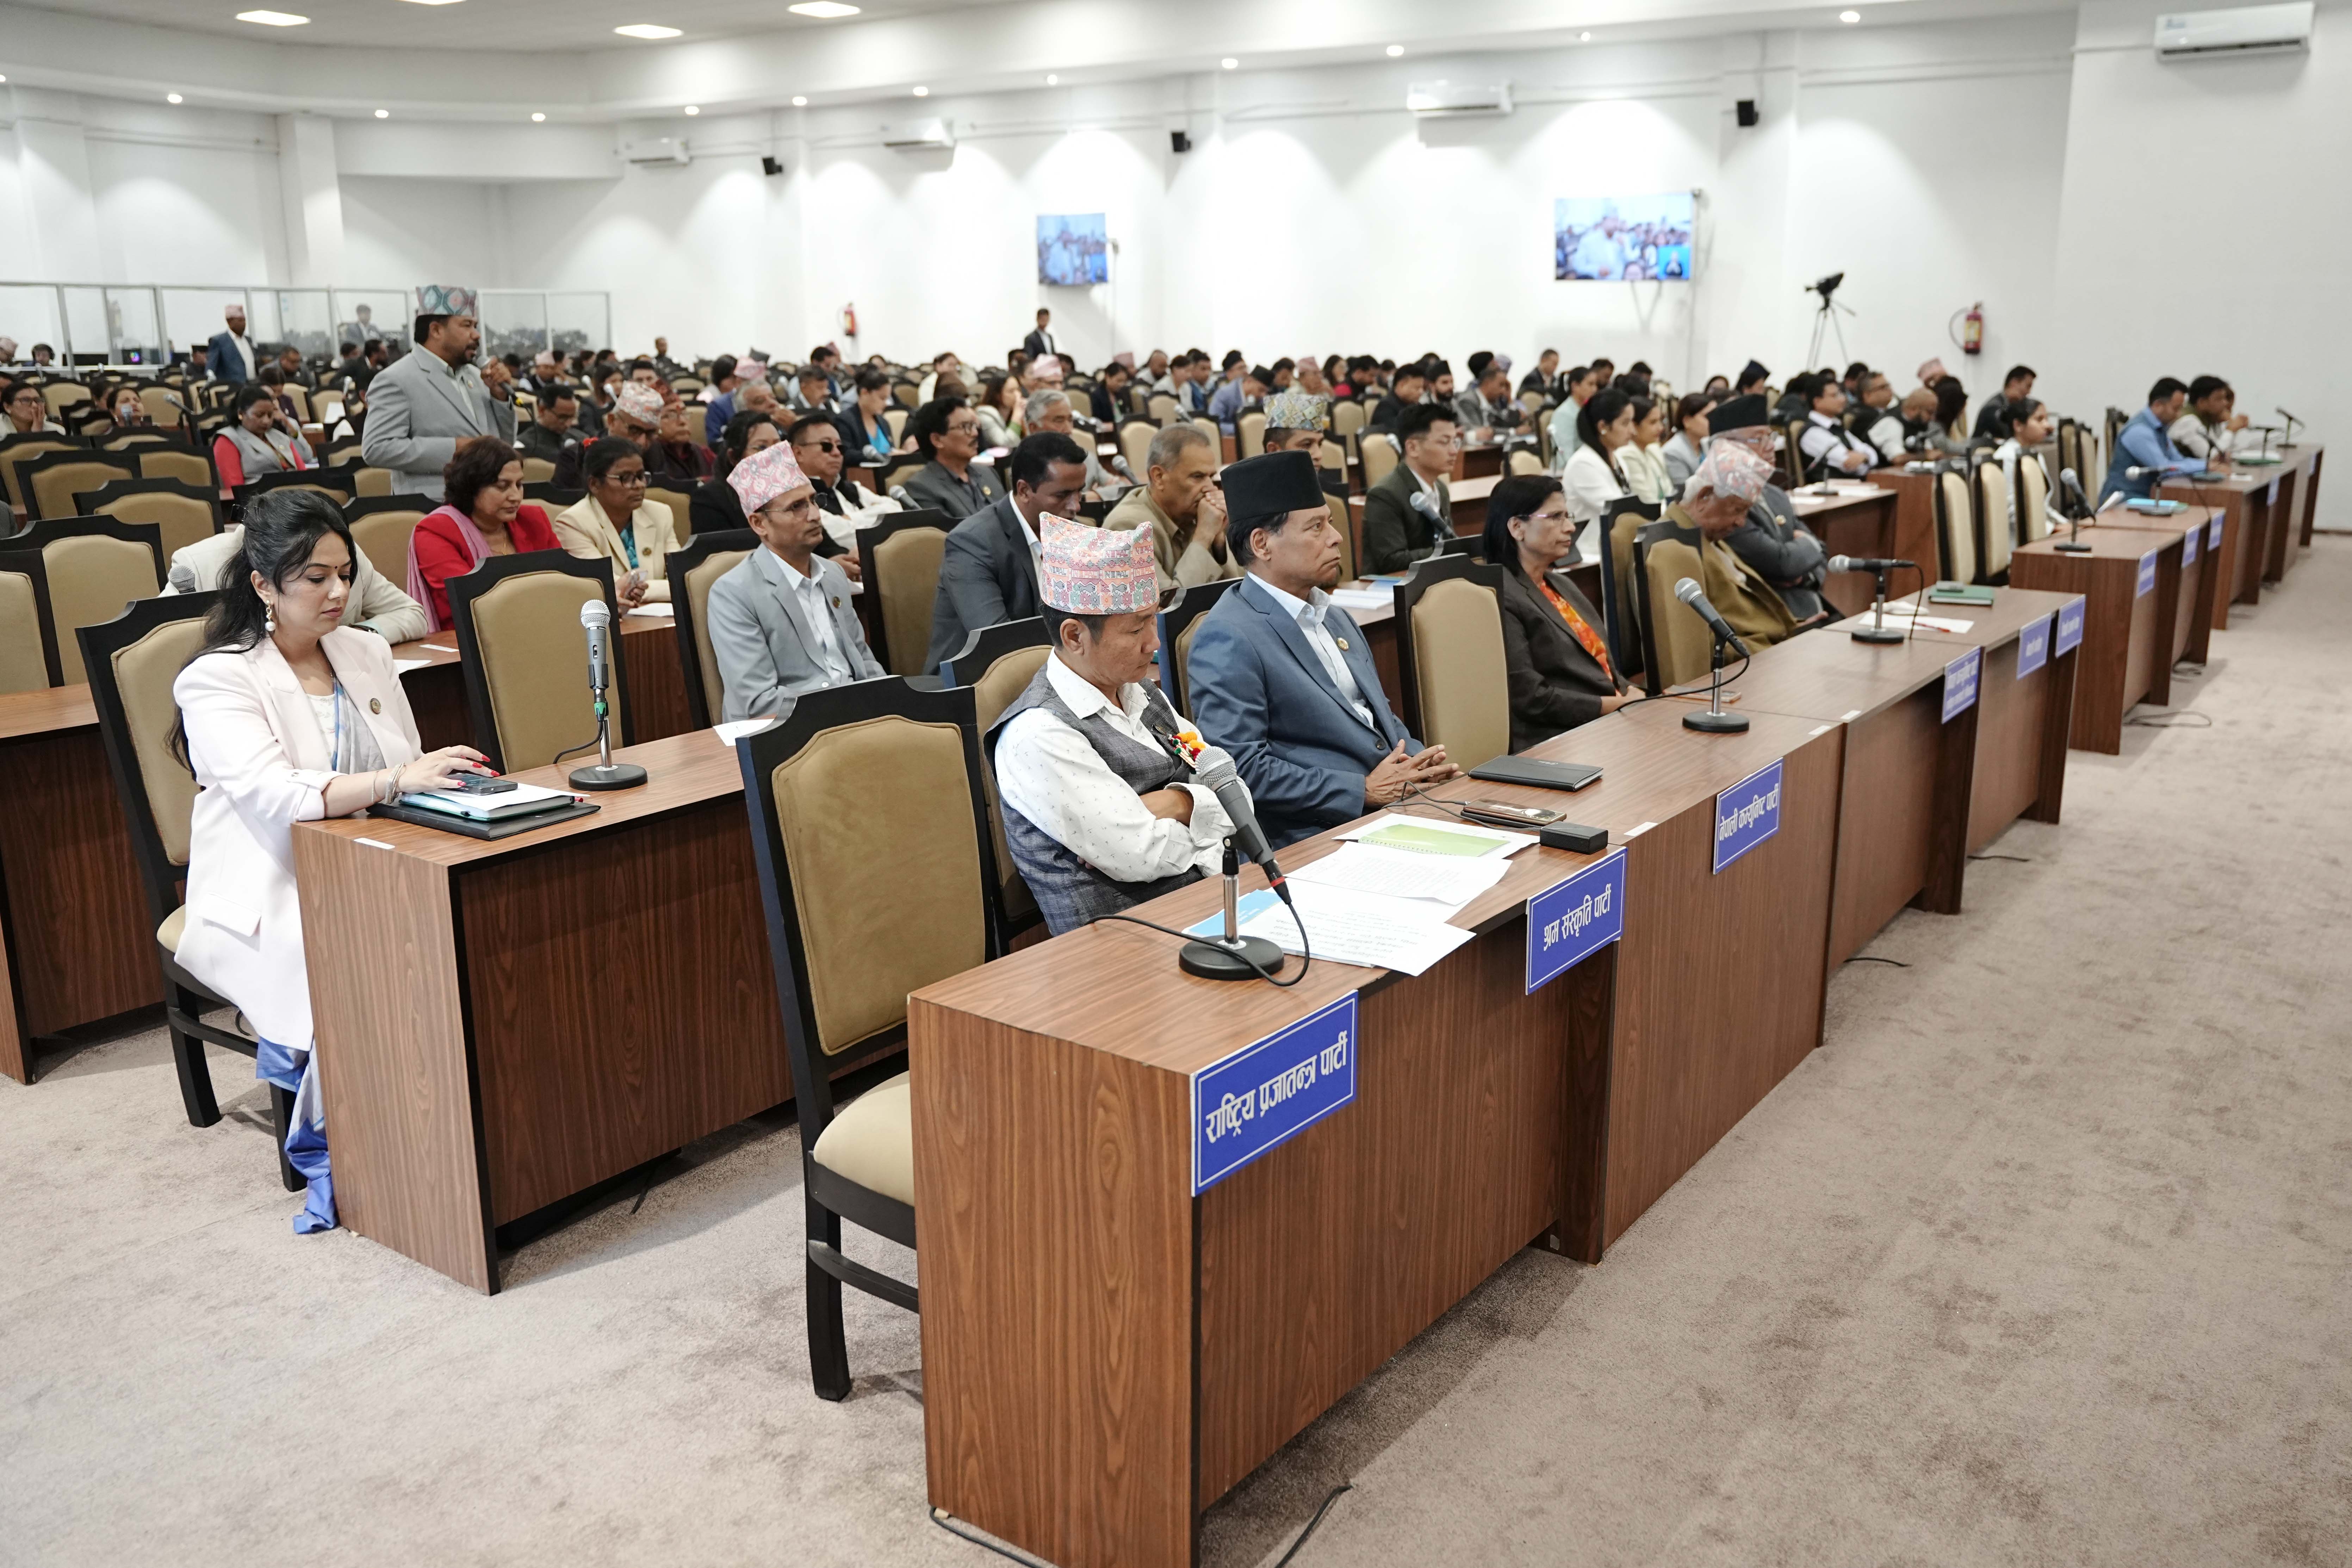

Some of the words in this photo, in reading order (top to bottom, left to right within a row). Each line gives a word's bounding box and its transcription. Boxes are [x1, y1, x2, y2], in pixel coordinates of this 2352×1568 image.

[1049, 565, 1067, 576] NEPAL
[1105, 550, 1128, 558] NEPAL
[1719, 807, 1738, 841] नेपाली
[1766, 783, 1779, 811] पार्टी
[1544, 919, 1560, 951] श्रम
[1561, 894, 1593, 940] संस्कृति
[1594, 883, 1611, 918] पार्टी
[1205, 1089, 1256, 1144] राष्ट्रिय
[1259, 1055, 1317, 1118] प्रजातन्त्र
[1320, 1030, 1348, 1076] पार्टी
